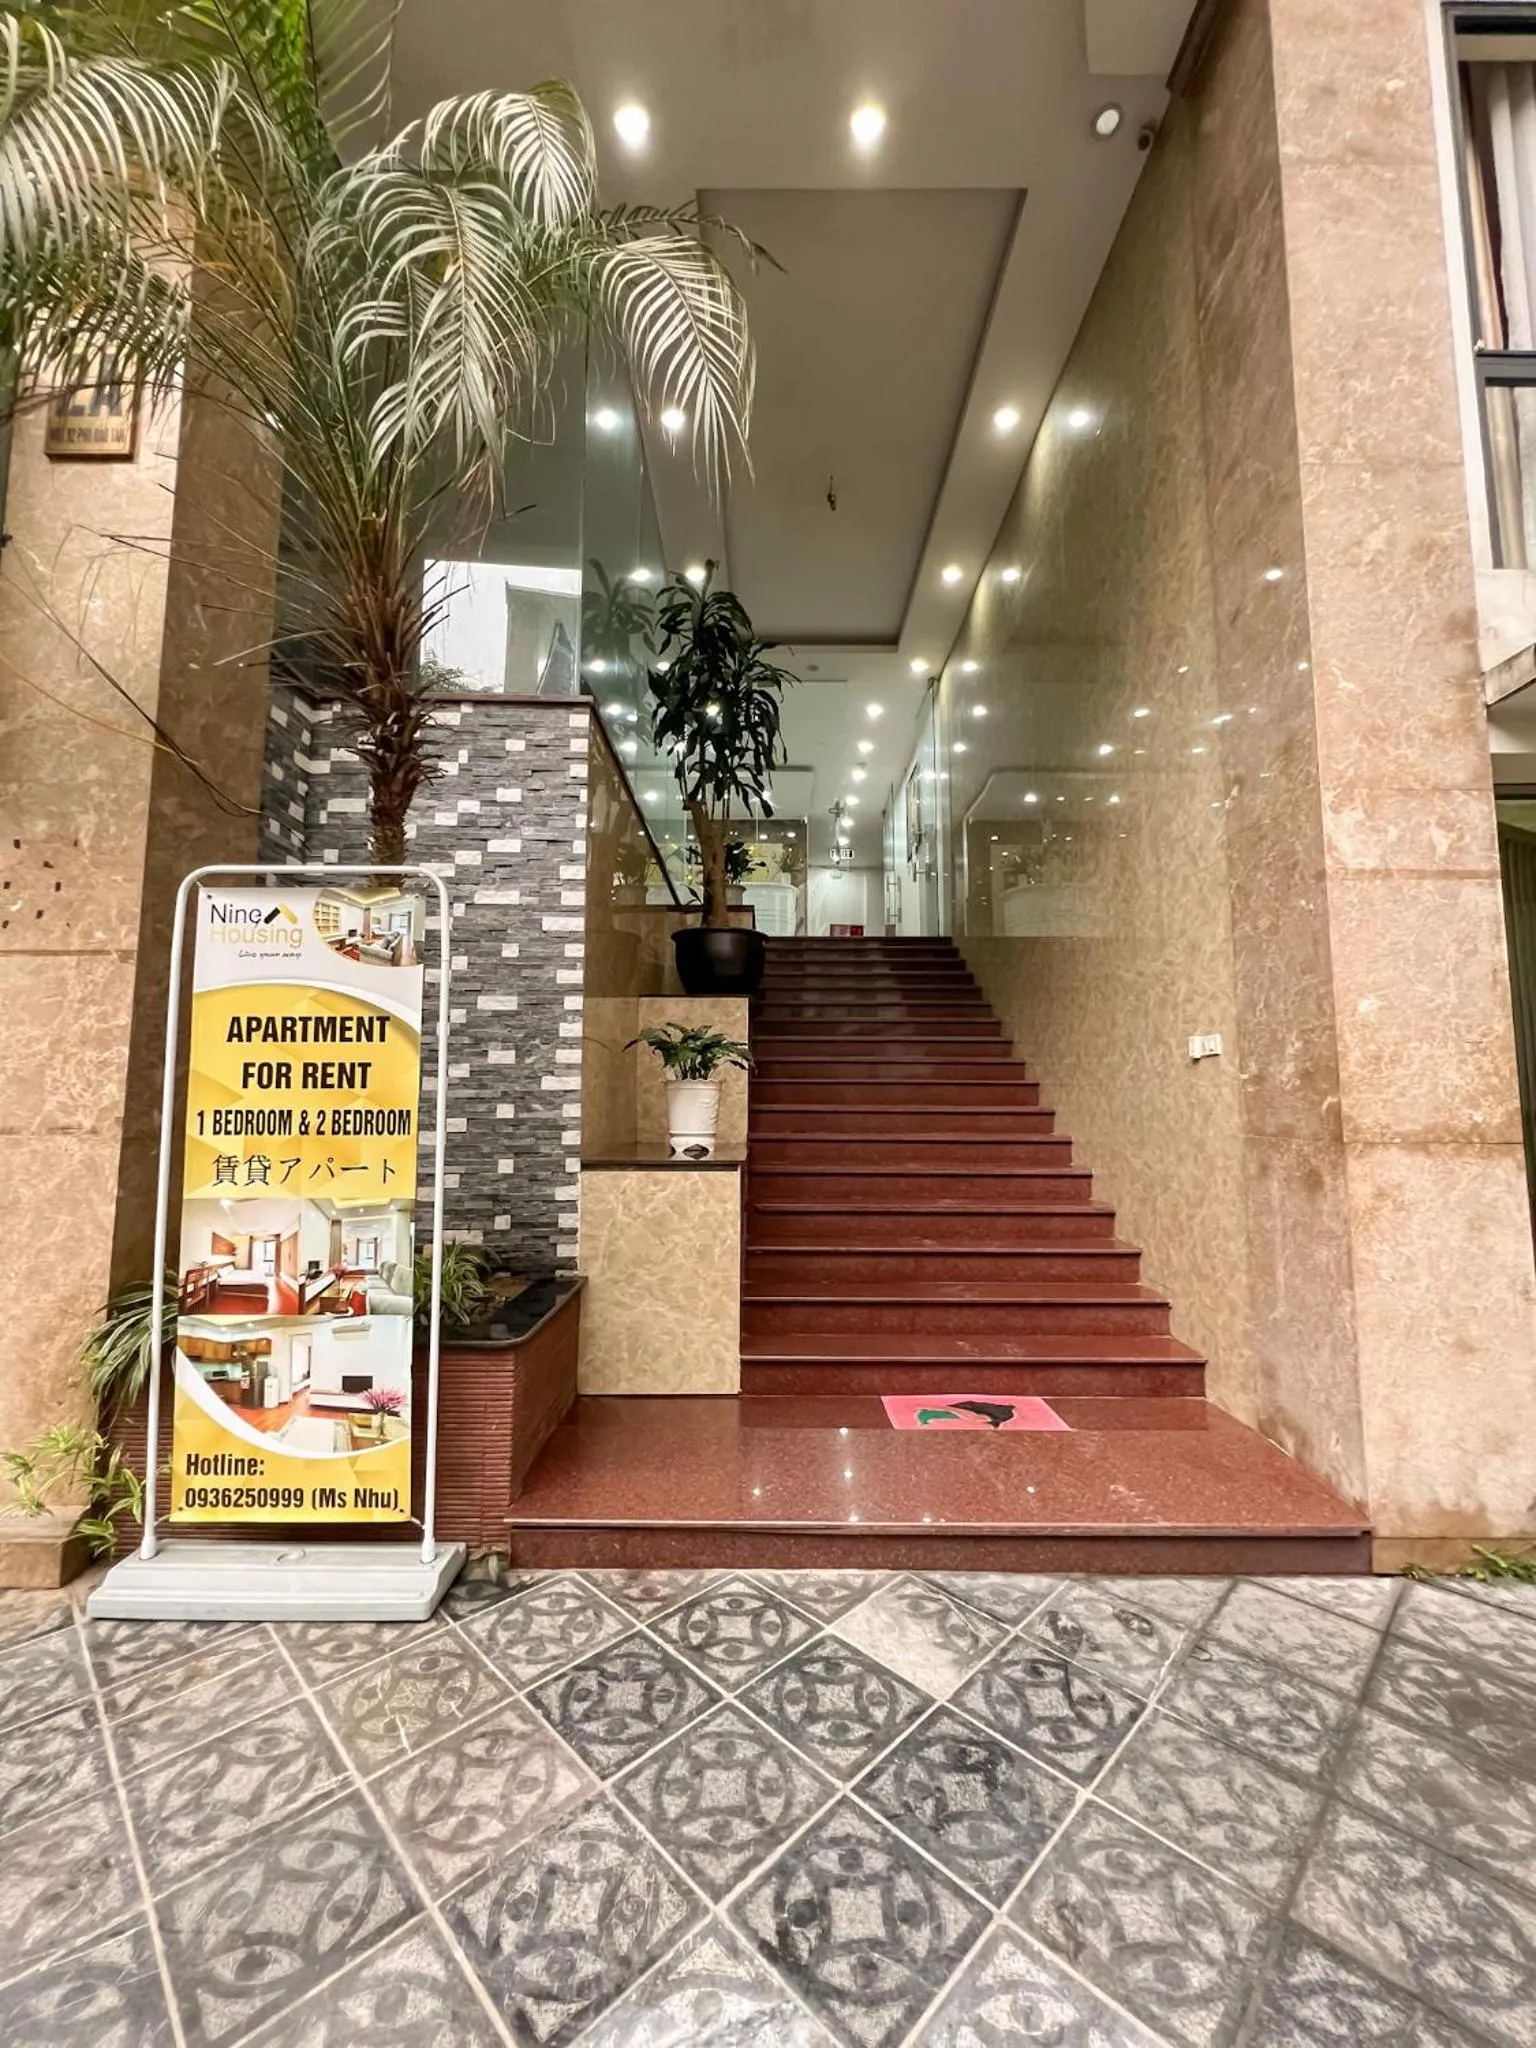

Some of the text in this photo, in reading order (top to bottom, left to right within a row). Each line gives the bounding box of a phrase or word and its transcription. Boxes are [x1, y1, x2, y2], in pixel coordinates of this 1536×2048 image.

[210, 903, 262, 926] Nine
[210, 925, 303, 949] Housing
[226, 1016, 391, 1043] APARTMENT
[241, 1062, 372, 1089] FOR RENT
[197, 1109, 411, 1136] 1 BEDROOM & 2 BEDROOM
[211, 1154, 396, 1187] 賃貸アパート
[186, 1453, 265, 1476] Hotline:
[185, 1487, 398, 1511] 0936250999 (Ms Nhu)
